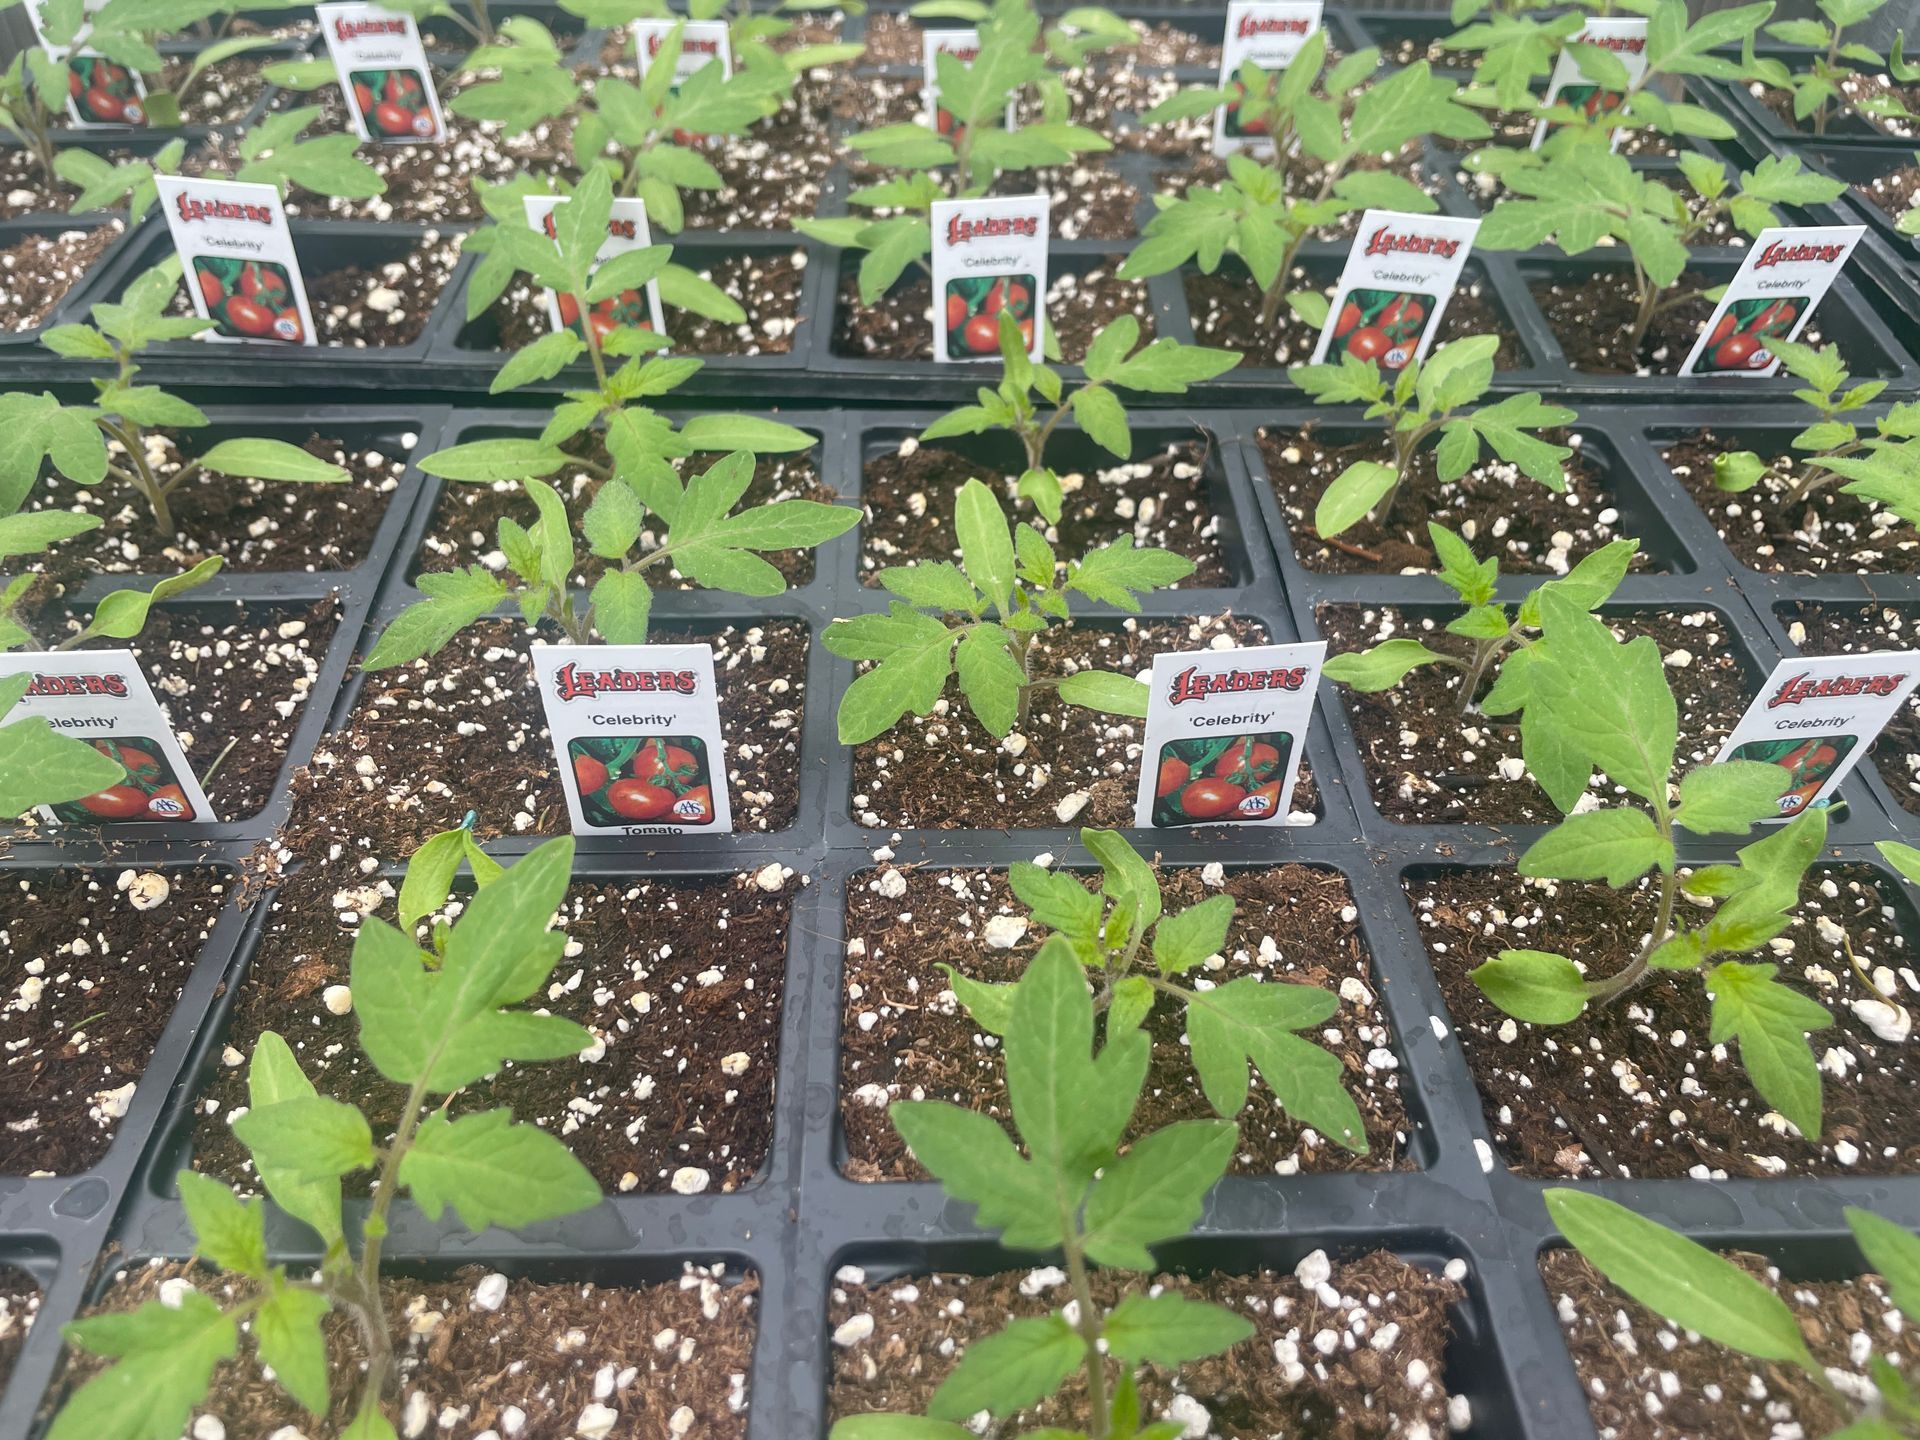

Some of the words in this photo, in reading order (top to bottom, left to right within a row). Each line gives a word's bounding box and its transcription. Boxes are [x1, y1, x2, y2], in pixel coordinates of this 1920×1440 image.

[176, 191, 272, 225] LEADERS
[946, 212, 1039, 247] LEADERS
[1364, 225, 1462, 260] LEADERS
[1753, 239, 1846, 271] LEADERS
[1373, 269, 1430, 285] 'Celebrity'
[1756, 278, 1810, 290] 'Celebrity'
[18, 673, 128, 704] ADERS
[556, 661, 697, 703] LEADERS
[1168, 665, 1311, 706] LEADERS
[1767, 671, 1907, 710] LEADERS
[48, 716, 119, 729] elebrity'
[587, 714, 677, 727] 'Celebrity'
[1189, 711, 1275, 728] 'Celebrity'
[1774, 715, 1856, 731] 'Celebrity'
[679, 800, 701, 815] AAS
[622, 826, 683, 836] Tomato
